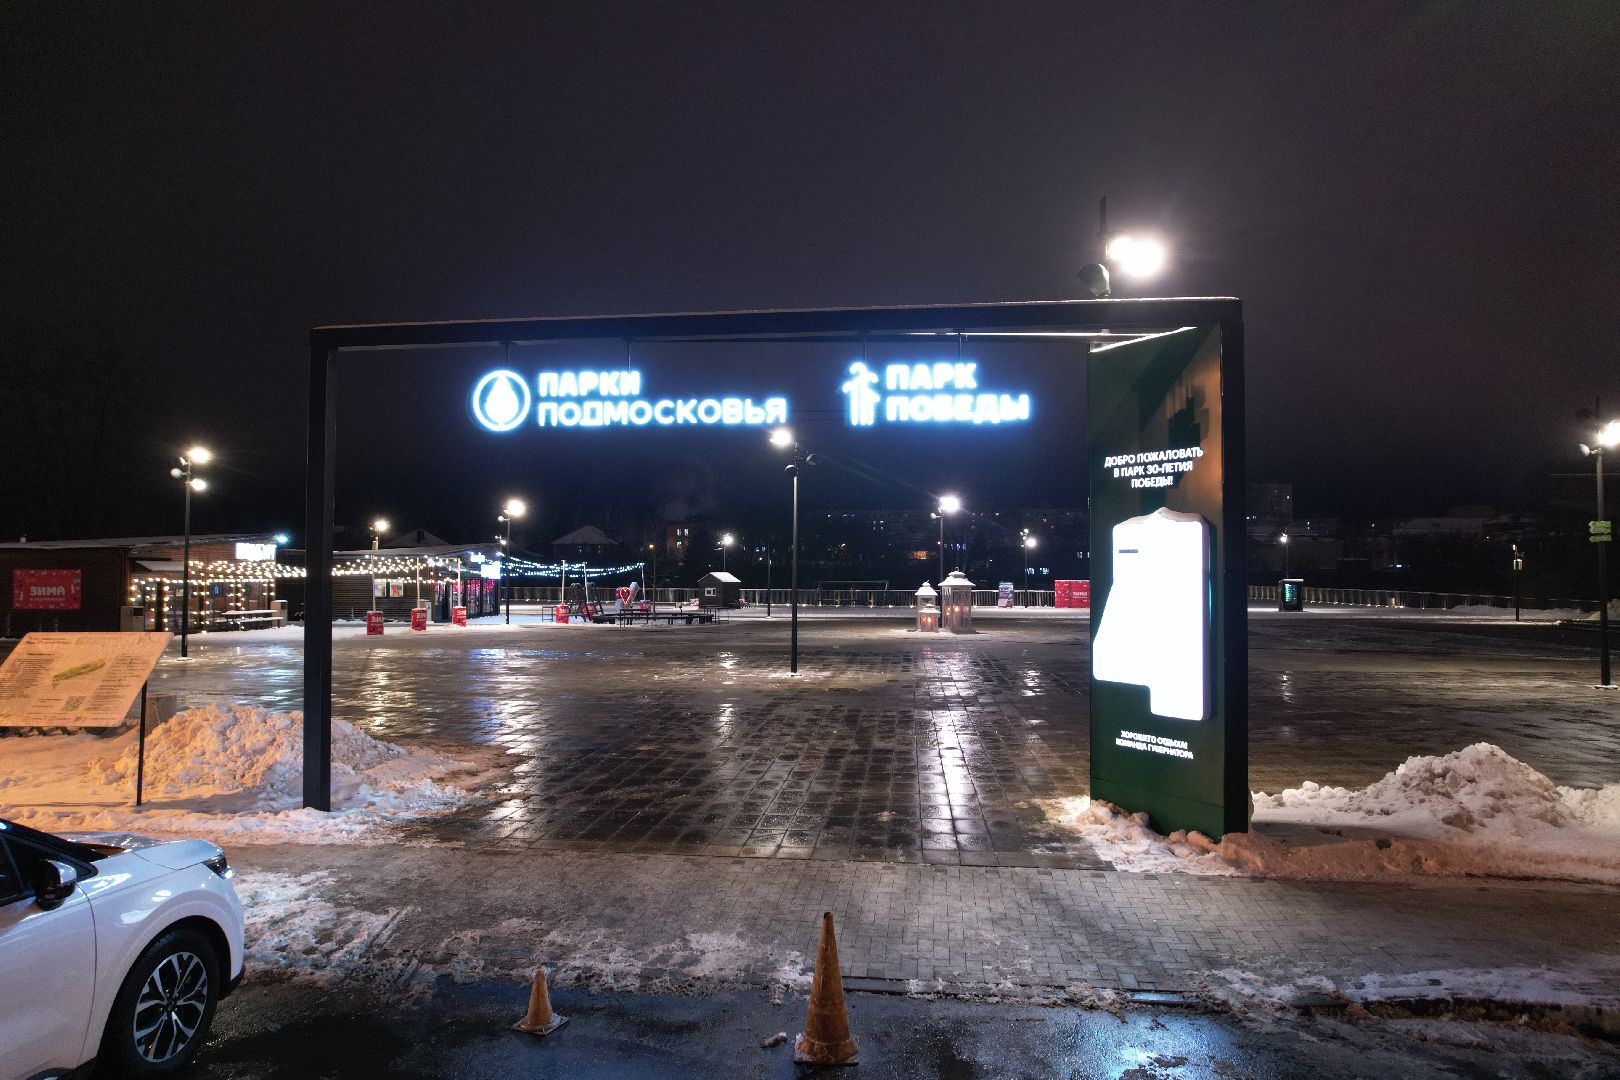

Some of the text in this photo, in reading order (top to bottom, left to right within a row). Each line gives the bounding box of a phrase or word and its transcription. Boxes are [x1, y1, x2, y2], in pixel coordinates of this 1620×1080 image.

[538, 371, 642, 397] ПАРКИ
[886, 362, 977, 390] ПАРК
[538, 398, 788, 427] ПОДМОСКОВЬЯ
[886, 393, 1030, 424] ПОБЕДЫ
[1104, 447, 1204, 468] ДОБРО ПОЖАЛОВАТЬ
[1113, 467, 1120, 478] В
[1121, 467, 1145, 477] ПАРК
[30, 586, 66, 596] ЗИМА
